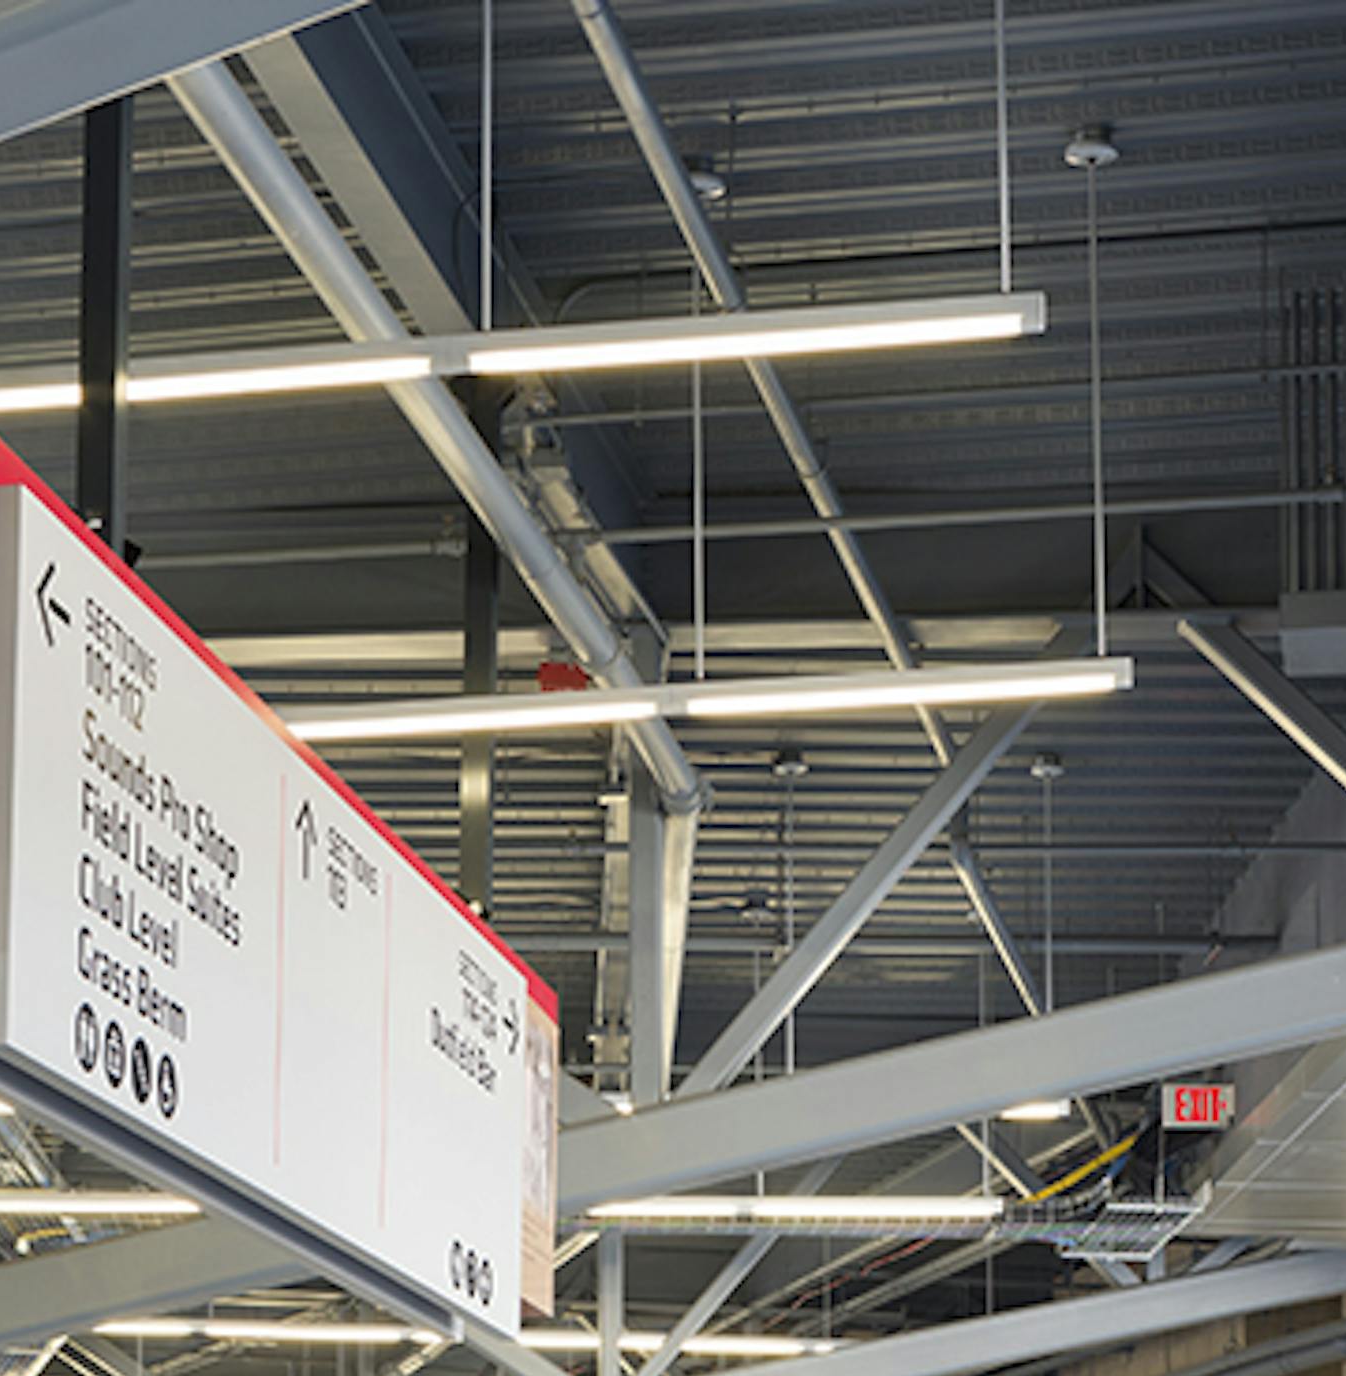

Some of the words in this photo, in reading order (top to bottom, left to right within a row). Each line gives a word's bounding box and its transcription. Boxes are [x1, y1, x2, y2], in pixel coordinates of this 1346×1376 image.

[85, 645, 144, 731] 101-112
[86, 597, 156, 692] SECTIONS
[81, 709, 155, 811] Sounds
[159, 774, 190, 840] Pro
[194, 804, 239, 890] Shop
[79, 854, 124, 928] Club
[128, 889, 179, 968] Level
[81, 780, 129, 862] Field
[135, 822, 184, 903] Level
[187, 866, 240, 945] Suites
[78, 926, 131, 1005] Grass
[138, 966, 188, 1042] Berm
[1175, 1087, 1222, 1122] EXIT
